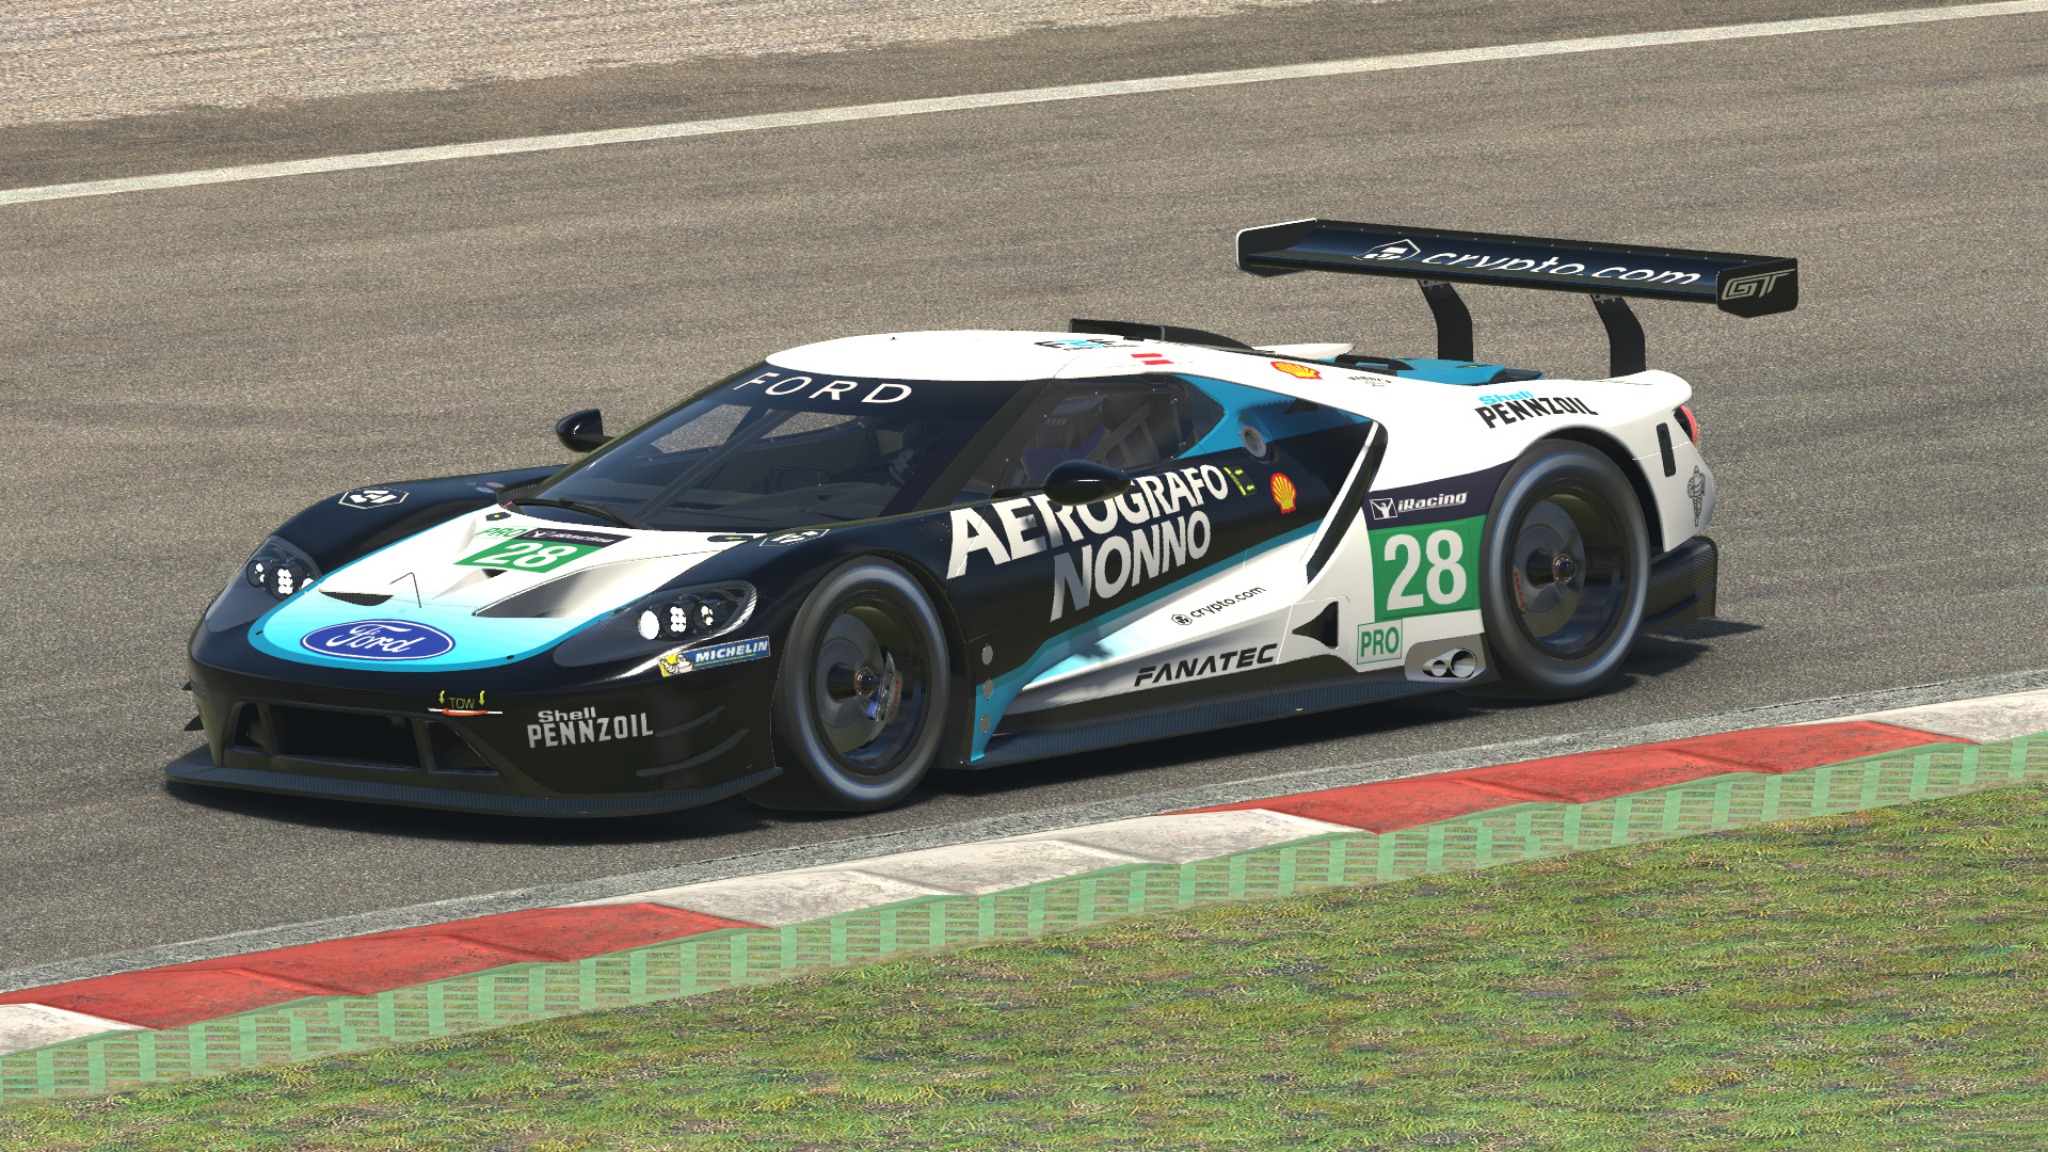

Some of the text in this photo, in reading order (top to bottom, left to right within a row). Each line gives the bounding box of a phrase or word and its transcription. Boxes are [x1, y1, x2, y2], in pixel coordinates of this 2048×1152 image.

[1421, 252, 1701, 285] crypto.com
[1721, 268, 1797, 301] GT
[732, 371, 912, 404] FORD
[1478, 390, 1535, 405] Shell
[1474, 397, 1600, 429] PENNZOIL
[1398, 492, 1469, 512] iRacing
[946, 464, 1229, 580] AEROGRAFO
[472, 542, 578, 568] 28
[1050, 510, 1212, 622] NONNO
[1384, 529, 1468, 611] 28
[1190, 586, 1267, 618] crypto.com
[325, 623, 426, 653] Ford
[695, 641, 768, 663] MICHELIN
[1360, 626, 1400, 657] PRO
[1134, 643, 1278, 687] FANATEC
[448, 697, 476, 709] TOW
[537, 706, 597, 723] Shell
[526, 712, 654, 748] PENNZOIL
